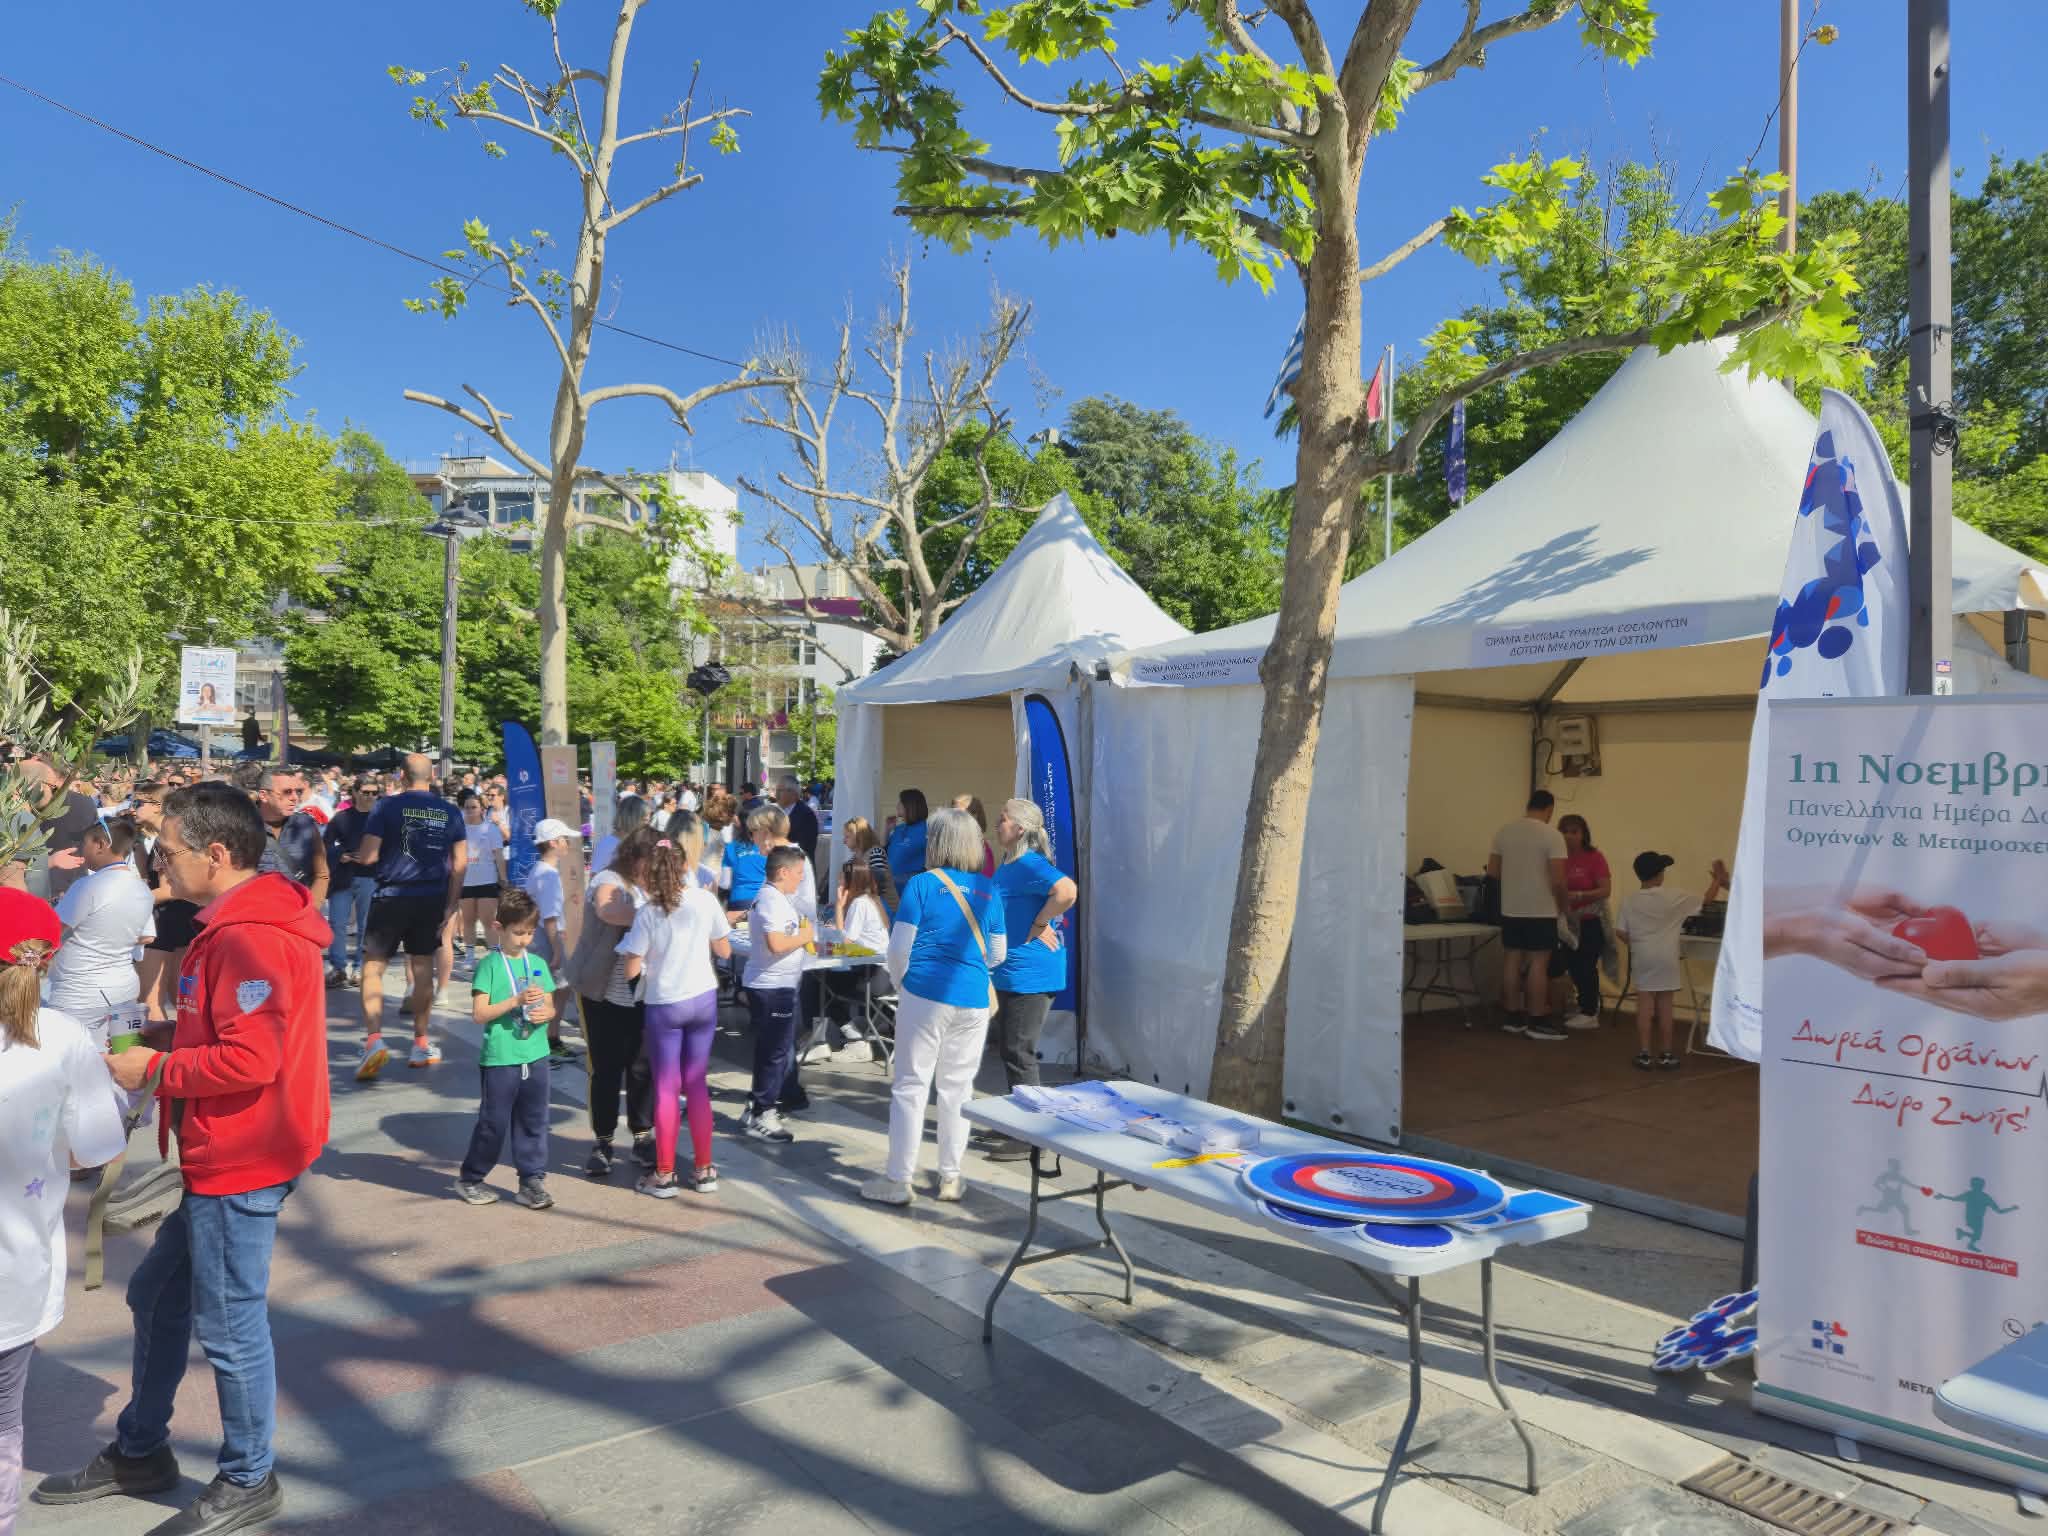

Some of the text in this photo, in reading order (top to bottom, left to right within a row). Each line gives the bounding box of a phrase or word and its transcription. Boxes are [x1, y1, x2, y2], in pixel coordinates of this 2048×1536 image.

[1510, 633, 1658, 656] ΔΟΤΩΝ ΜΥΕΛΟΥ ΤΩΝ ΟΣΤΩΝ
[1858, 752, 2048, 797] Νοεμβρ
[1788, 799, 1922, 821] Πανελλήνια
[1933, 803, 2011, 826] Ημέρα
[1787, 827, 2048, 854] Οργάνων & Μεταμοσχε
[1792, 1019, 2039, 1074] Δωρεά Οργάνων
[1852, 1083, 2030, 1134] Δώρο Ζωής!
[1898, 1378, 1936, 1395] ΜΕΤΑ
